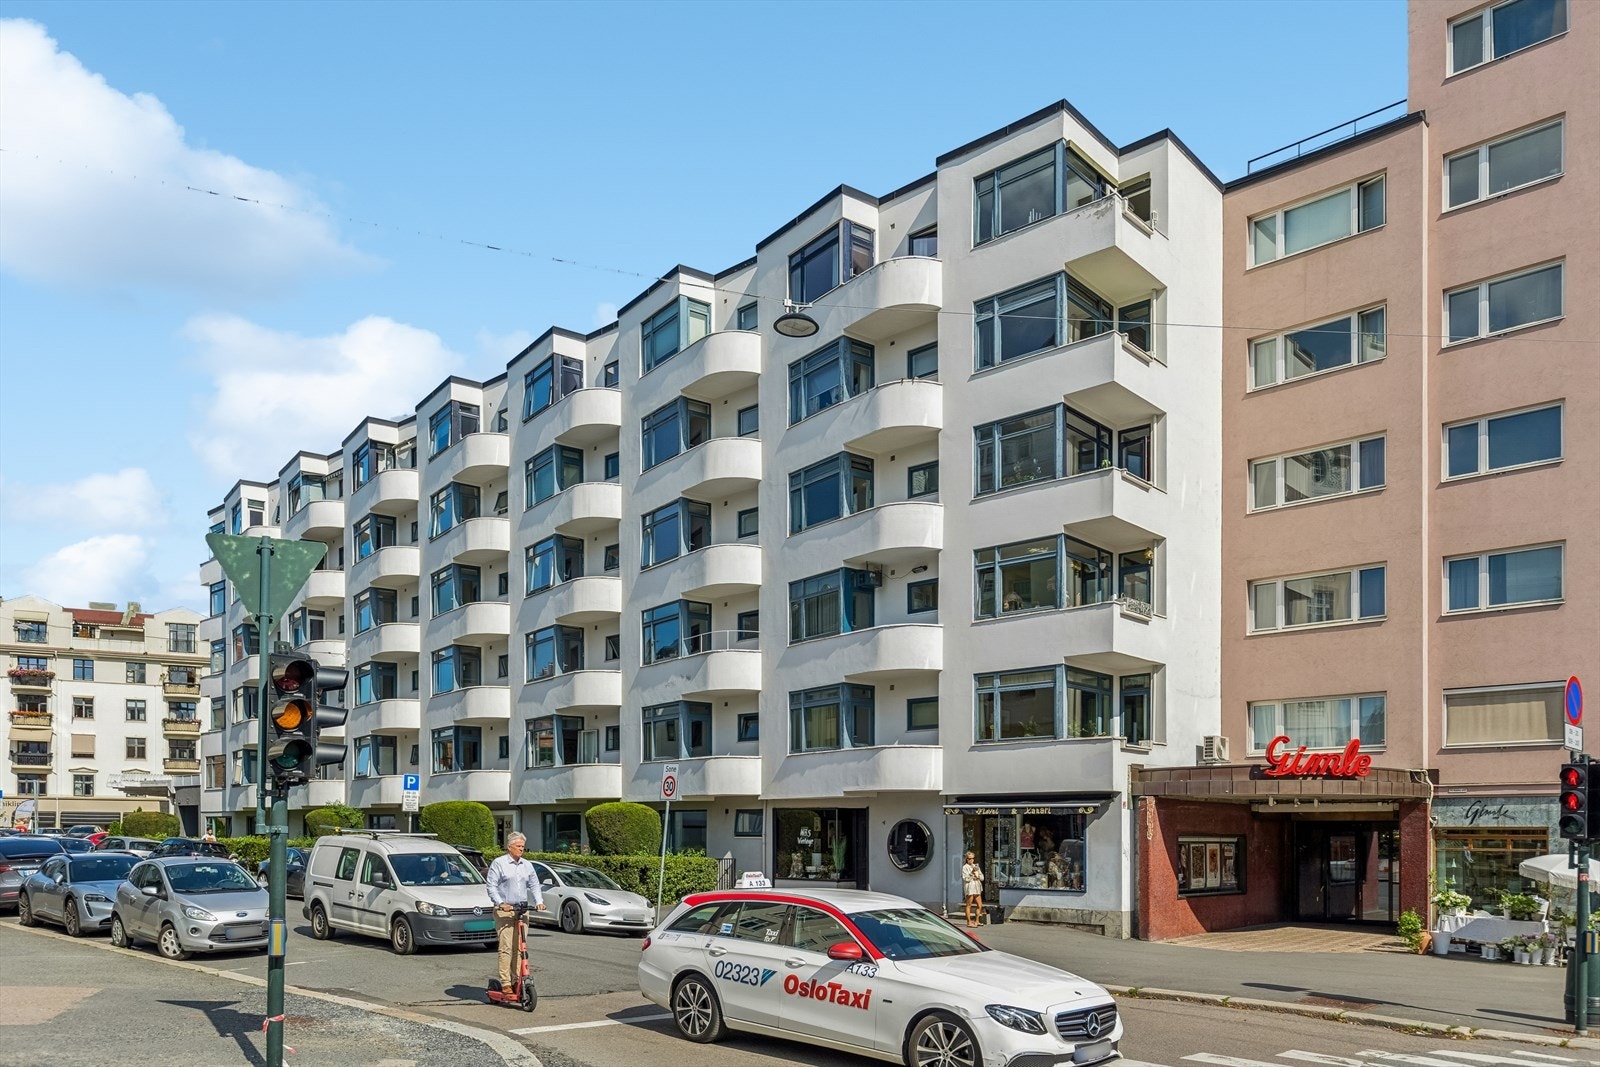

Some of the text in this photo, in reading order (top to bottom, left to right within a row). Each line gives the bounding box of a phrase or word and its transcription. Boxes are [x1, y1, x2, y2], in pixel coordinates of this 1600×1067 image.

[1264, 735, 1372, 776] Gimle
[407, 776, 416, 788] P
[665, 781, 674, 791] 30
[765, 928, 780, 937] Taxi
[714, 960, 760, 987] 02323
[844, 962, 878, 978] A133
[783, 974, 872, 1010] OsloTaxi
